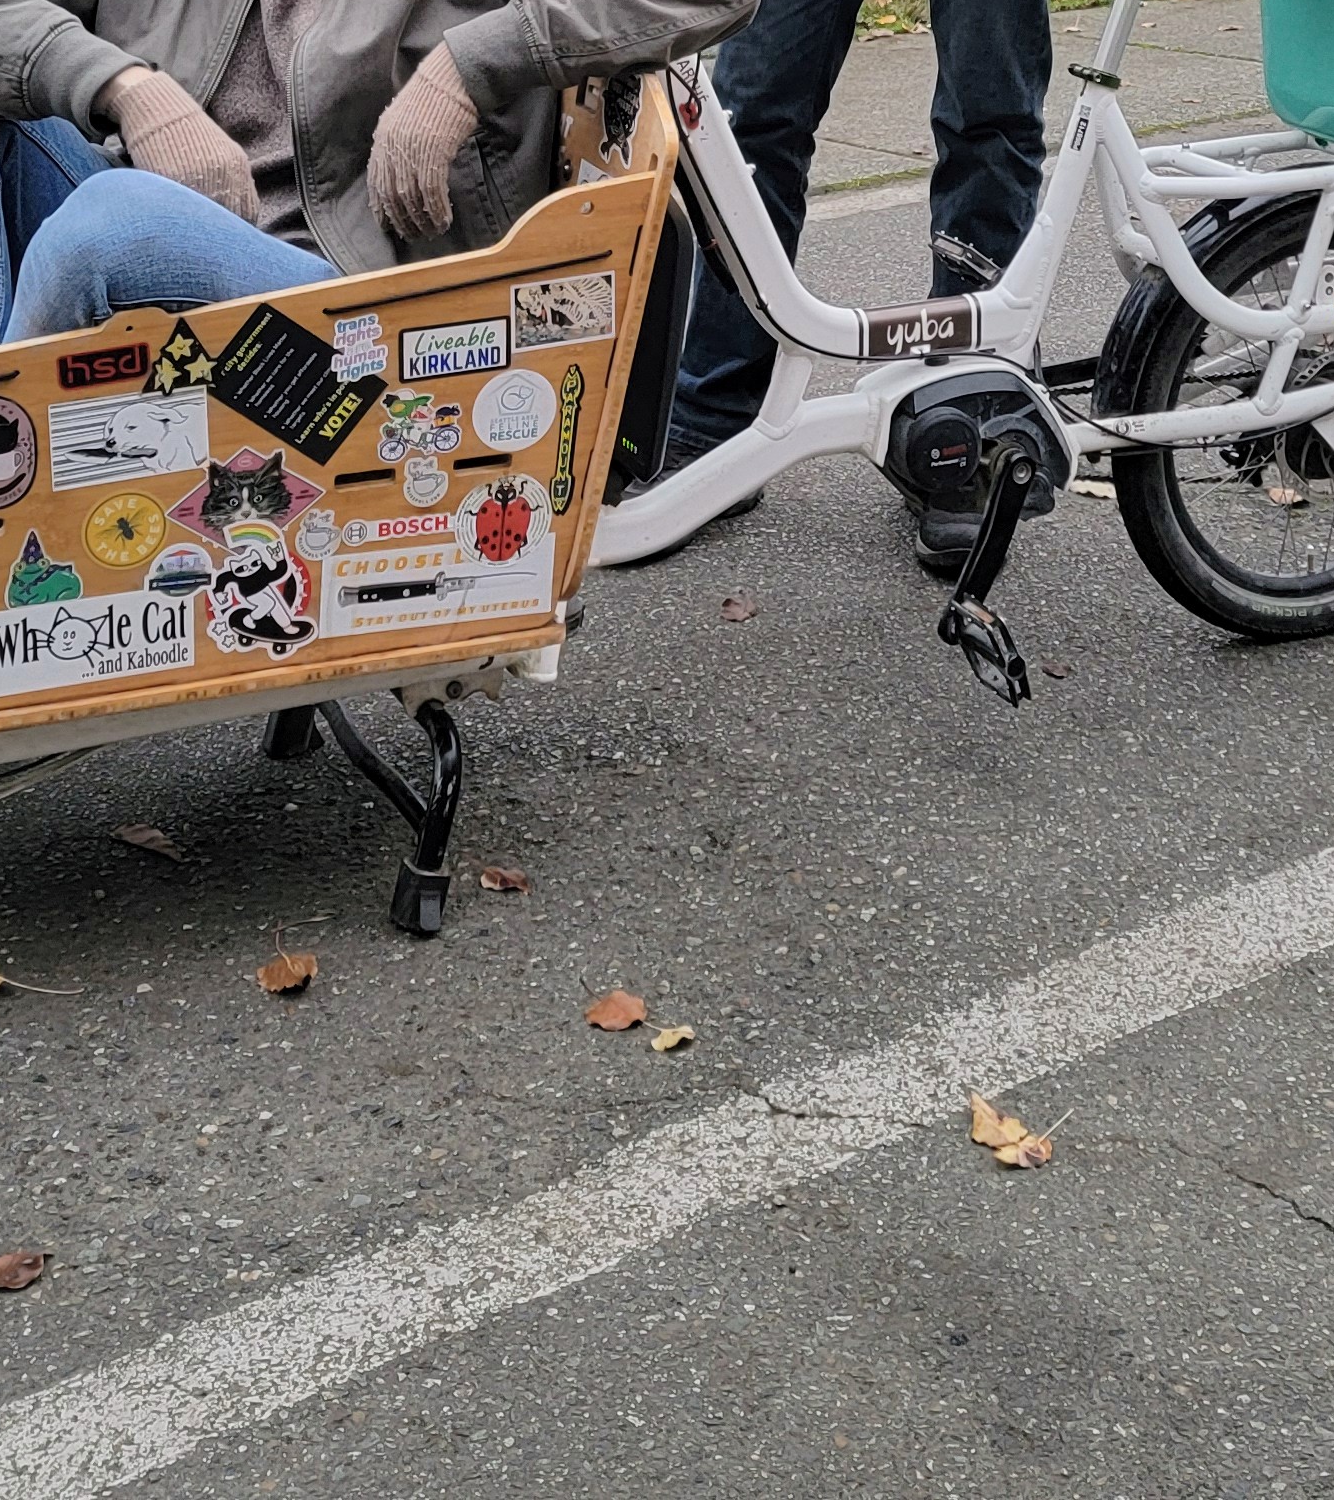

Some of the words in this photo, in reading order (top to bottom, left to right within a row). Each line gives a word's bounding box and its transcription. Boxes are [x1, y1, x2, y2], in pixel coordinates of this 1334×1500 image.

[236, 313, 272, 357] government
[336, 326, 380, 346] rights
[337, 315, 376, 333] trans
[886, 308, 955, 355] yuba
[415, 326, 496, 355] Liveable
[67, 347, 141, 383] hsd
[333, 348, 386, 369] human
[340, 359, 384, 380] rights
[409, 346, 501, 377] KIRKLAND
[319, 393, 363, 440] VOTE!
[490, 420, 538, 432] FELINE
[295, 423, 315, 444] Learn
[490, 428, 538, 442] RESCUE
[94, 498, 137, 526] SAVE
[96, 541, 130, 562] THE
[136, 514, 160, 556] BEES
[378, 515, 448, 538] BOSCH
[337, 550, 444, 577] CHOOSE
[142, 600, 187, 644] Cat
[127, 643, 189, 670] Kaboodle
